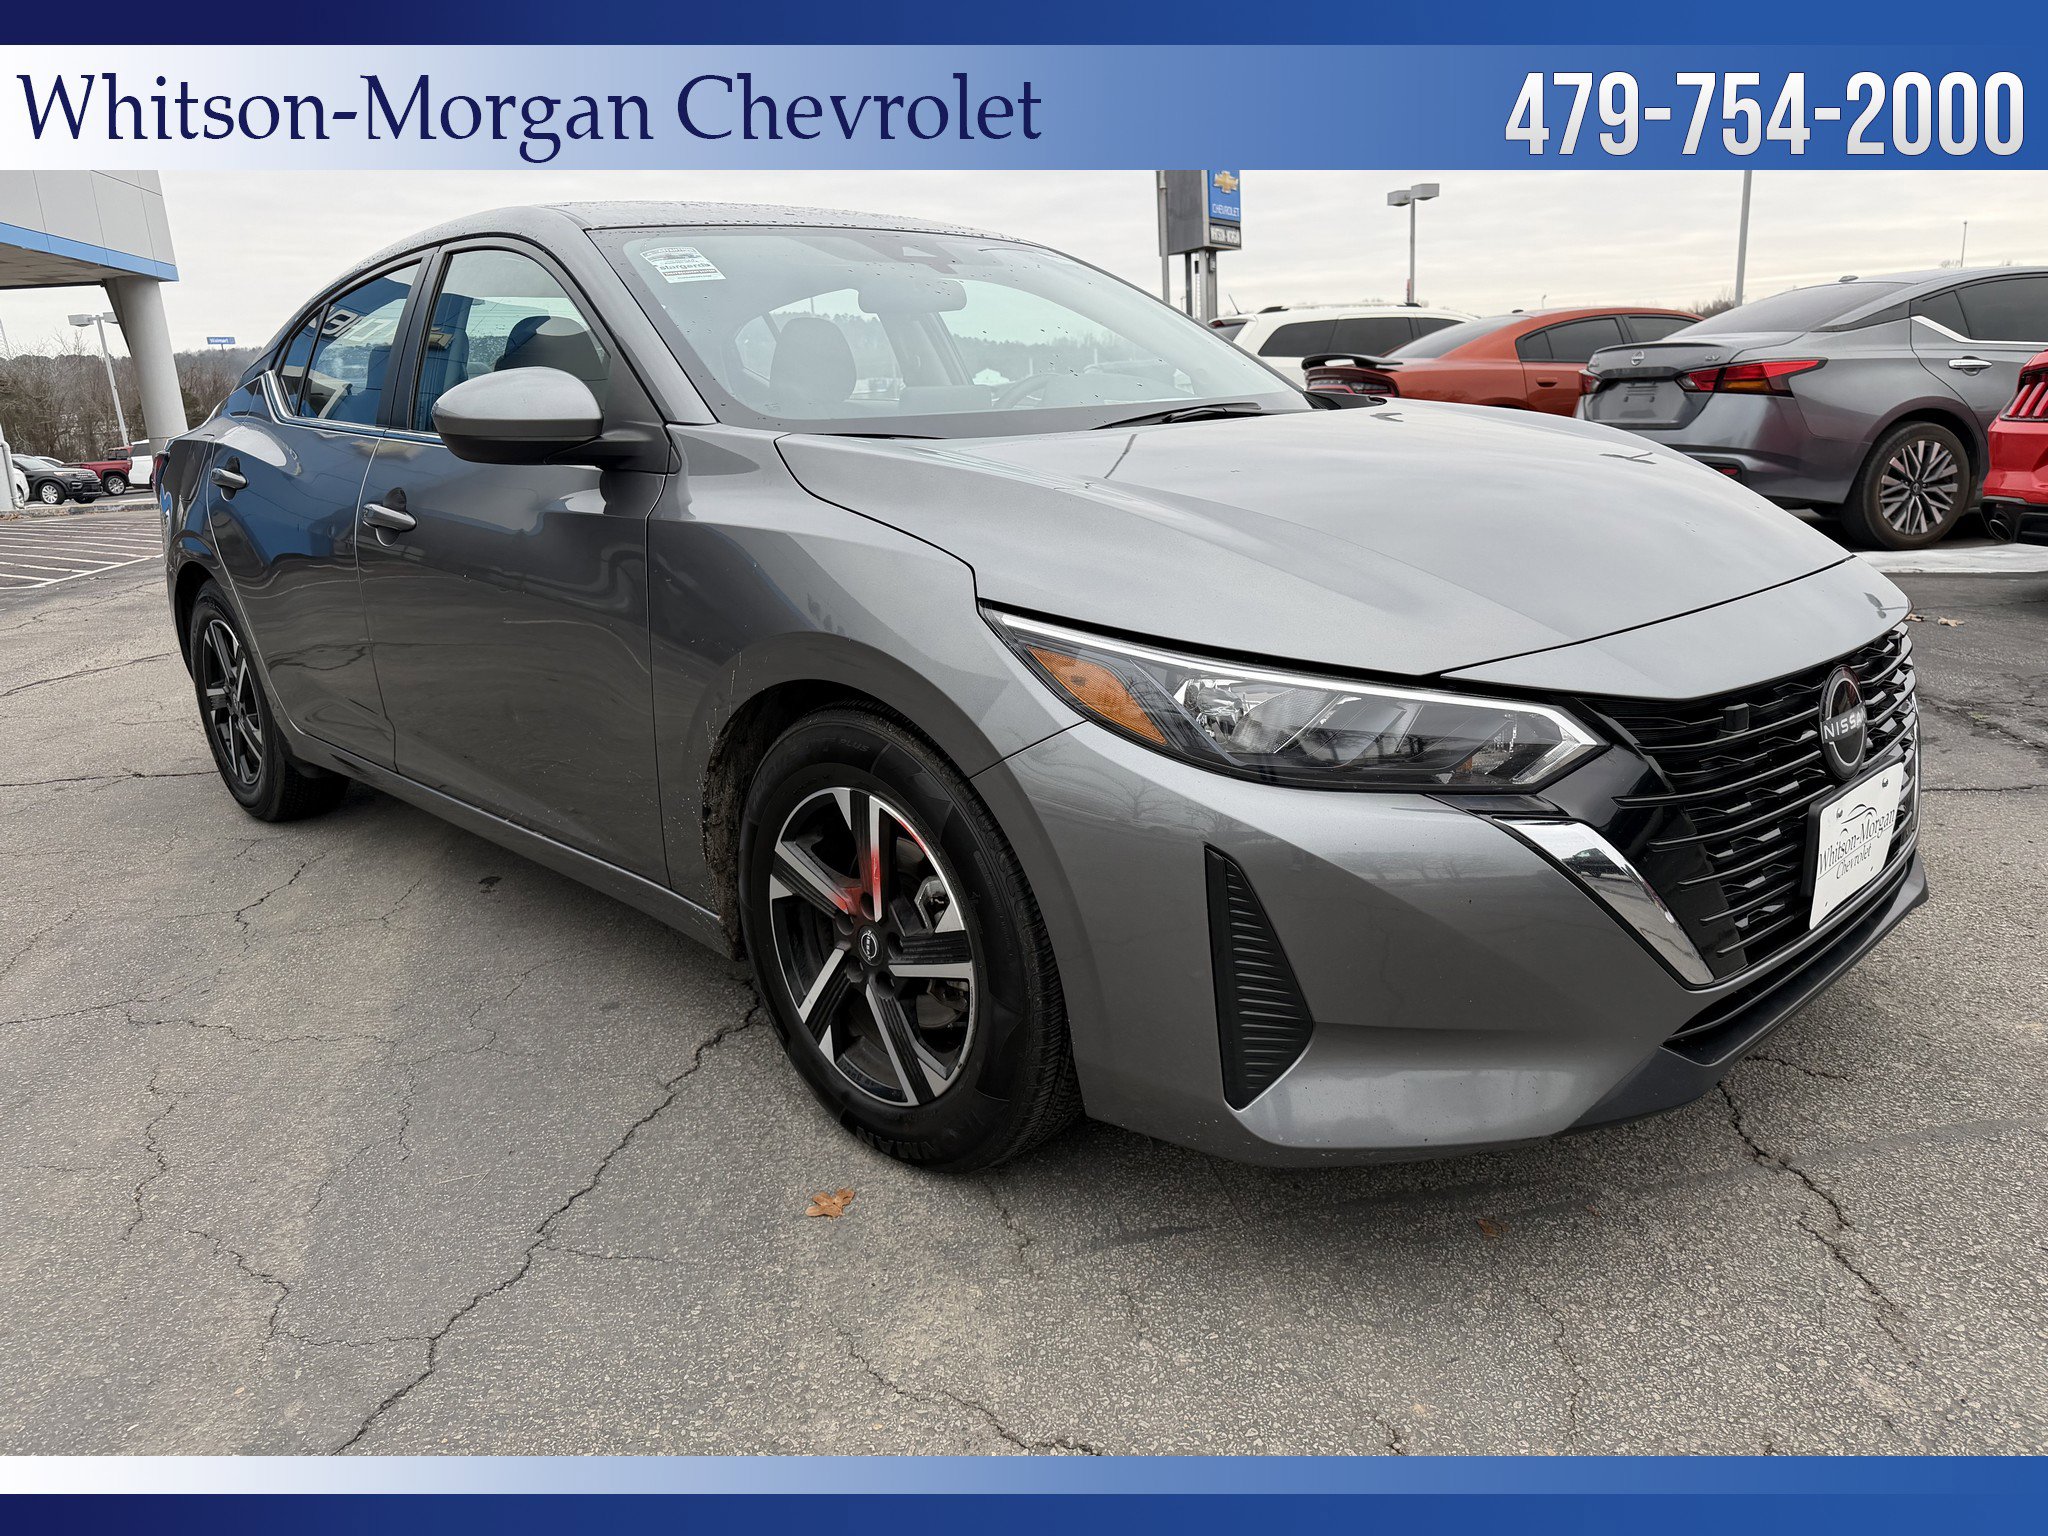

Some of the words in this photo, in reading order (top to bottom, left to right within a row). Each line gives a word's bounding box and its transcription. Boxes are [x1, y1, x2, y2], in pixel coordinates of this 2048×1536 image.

[1823, 707, 1866, 740] NISSAN
[1818, 809, 1895, 875] Whitson-Morgan
[1836, 843, 1872, 880] Chevrolet
